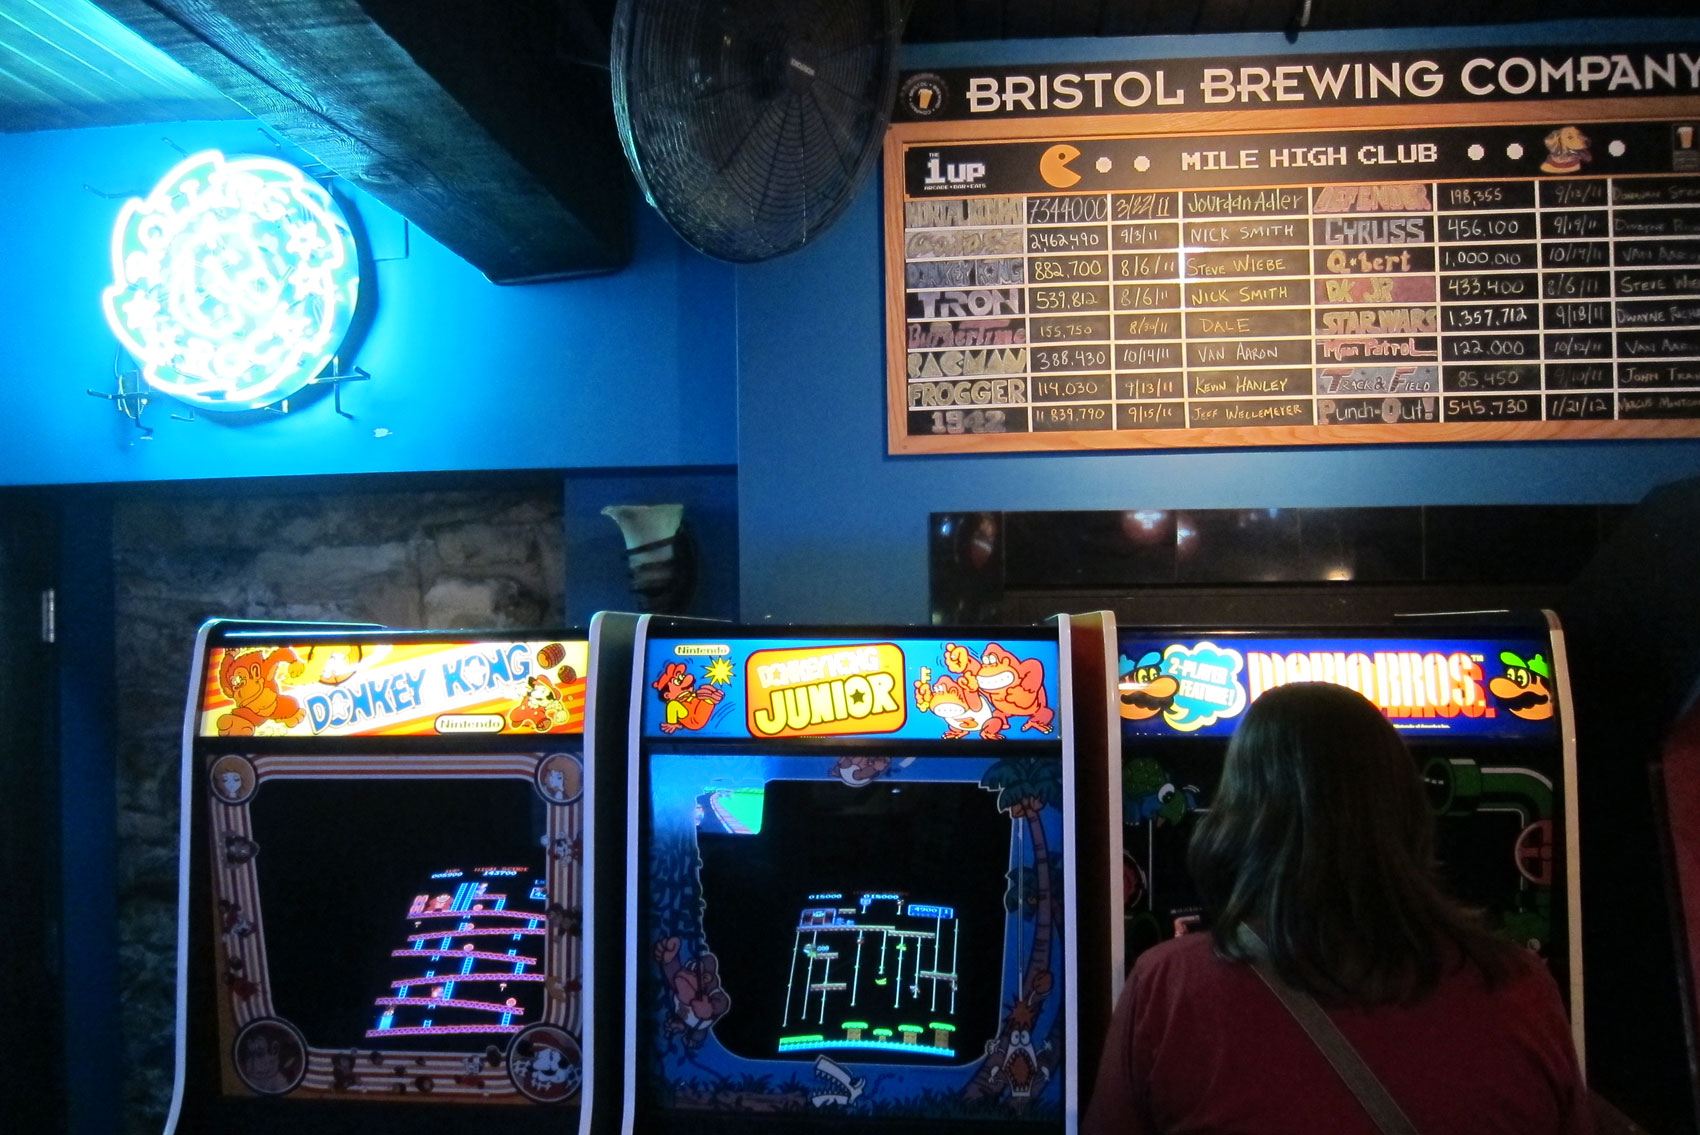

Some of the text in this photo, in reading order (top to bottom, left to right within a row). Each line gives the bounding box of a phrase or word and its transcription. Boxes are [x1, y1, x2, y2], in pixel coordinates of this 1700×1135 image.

[966, 52, 1700, 112] BRISTOL BREWING COMPANY
[1182, 143, 1438, 171] MILE HIGH CLUB
[1253, 188, 1303, 212] Adler
[1121, 226, 1157, 244] 9/3/11
[1191, 225, 1294, 243] NICK SMITH
[1325, 218, 1425, 245] GYRUSS
[1121, 256, 1175, 277] 8/6/11
[1187, 254, 1286, 276] STEVE WIEBE
[1326, 279, 1356, 303] DK
[1621, 276, 1666, 292] STEVE
[917, 289, 1020, 319] TRON
[1121, 287, 1168, 308] 8/6/11
[1192, 286, 1288, 306] NICK SMITH
[1199, 318, 1250, 333] DALE
[1317, 310, 1379, 335] STAR
[1123, 348, 1169, 365] 10/14/11
[1198, 342, 1278, 363] VAN AARON
[1236, 375, 1288, 393] HANLEY
[1320, 366, 1431, 393] TRACK & FIELD
[1621, 368, 1659, 383] JOHN
[908, 379, 1027, 407] FROGGER
[1191, 407, 1218, 421] JEFF
[1552, 397, 1607, 417] 1/21/12
[931, 410, 1006, 433] 1942
[677, 646, 728, 655] Nintendo
[826, 646, 880, 677] KONG
[304, 643, 533, 735] DONKEY KONG
[1374, 652, 1490, 714] BROS.
[754, 672, 899, 735] JUNIOR
[440, 717, 501, 731] Nintendo
